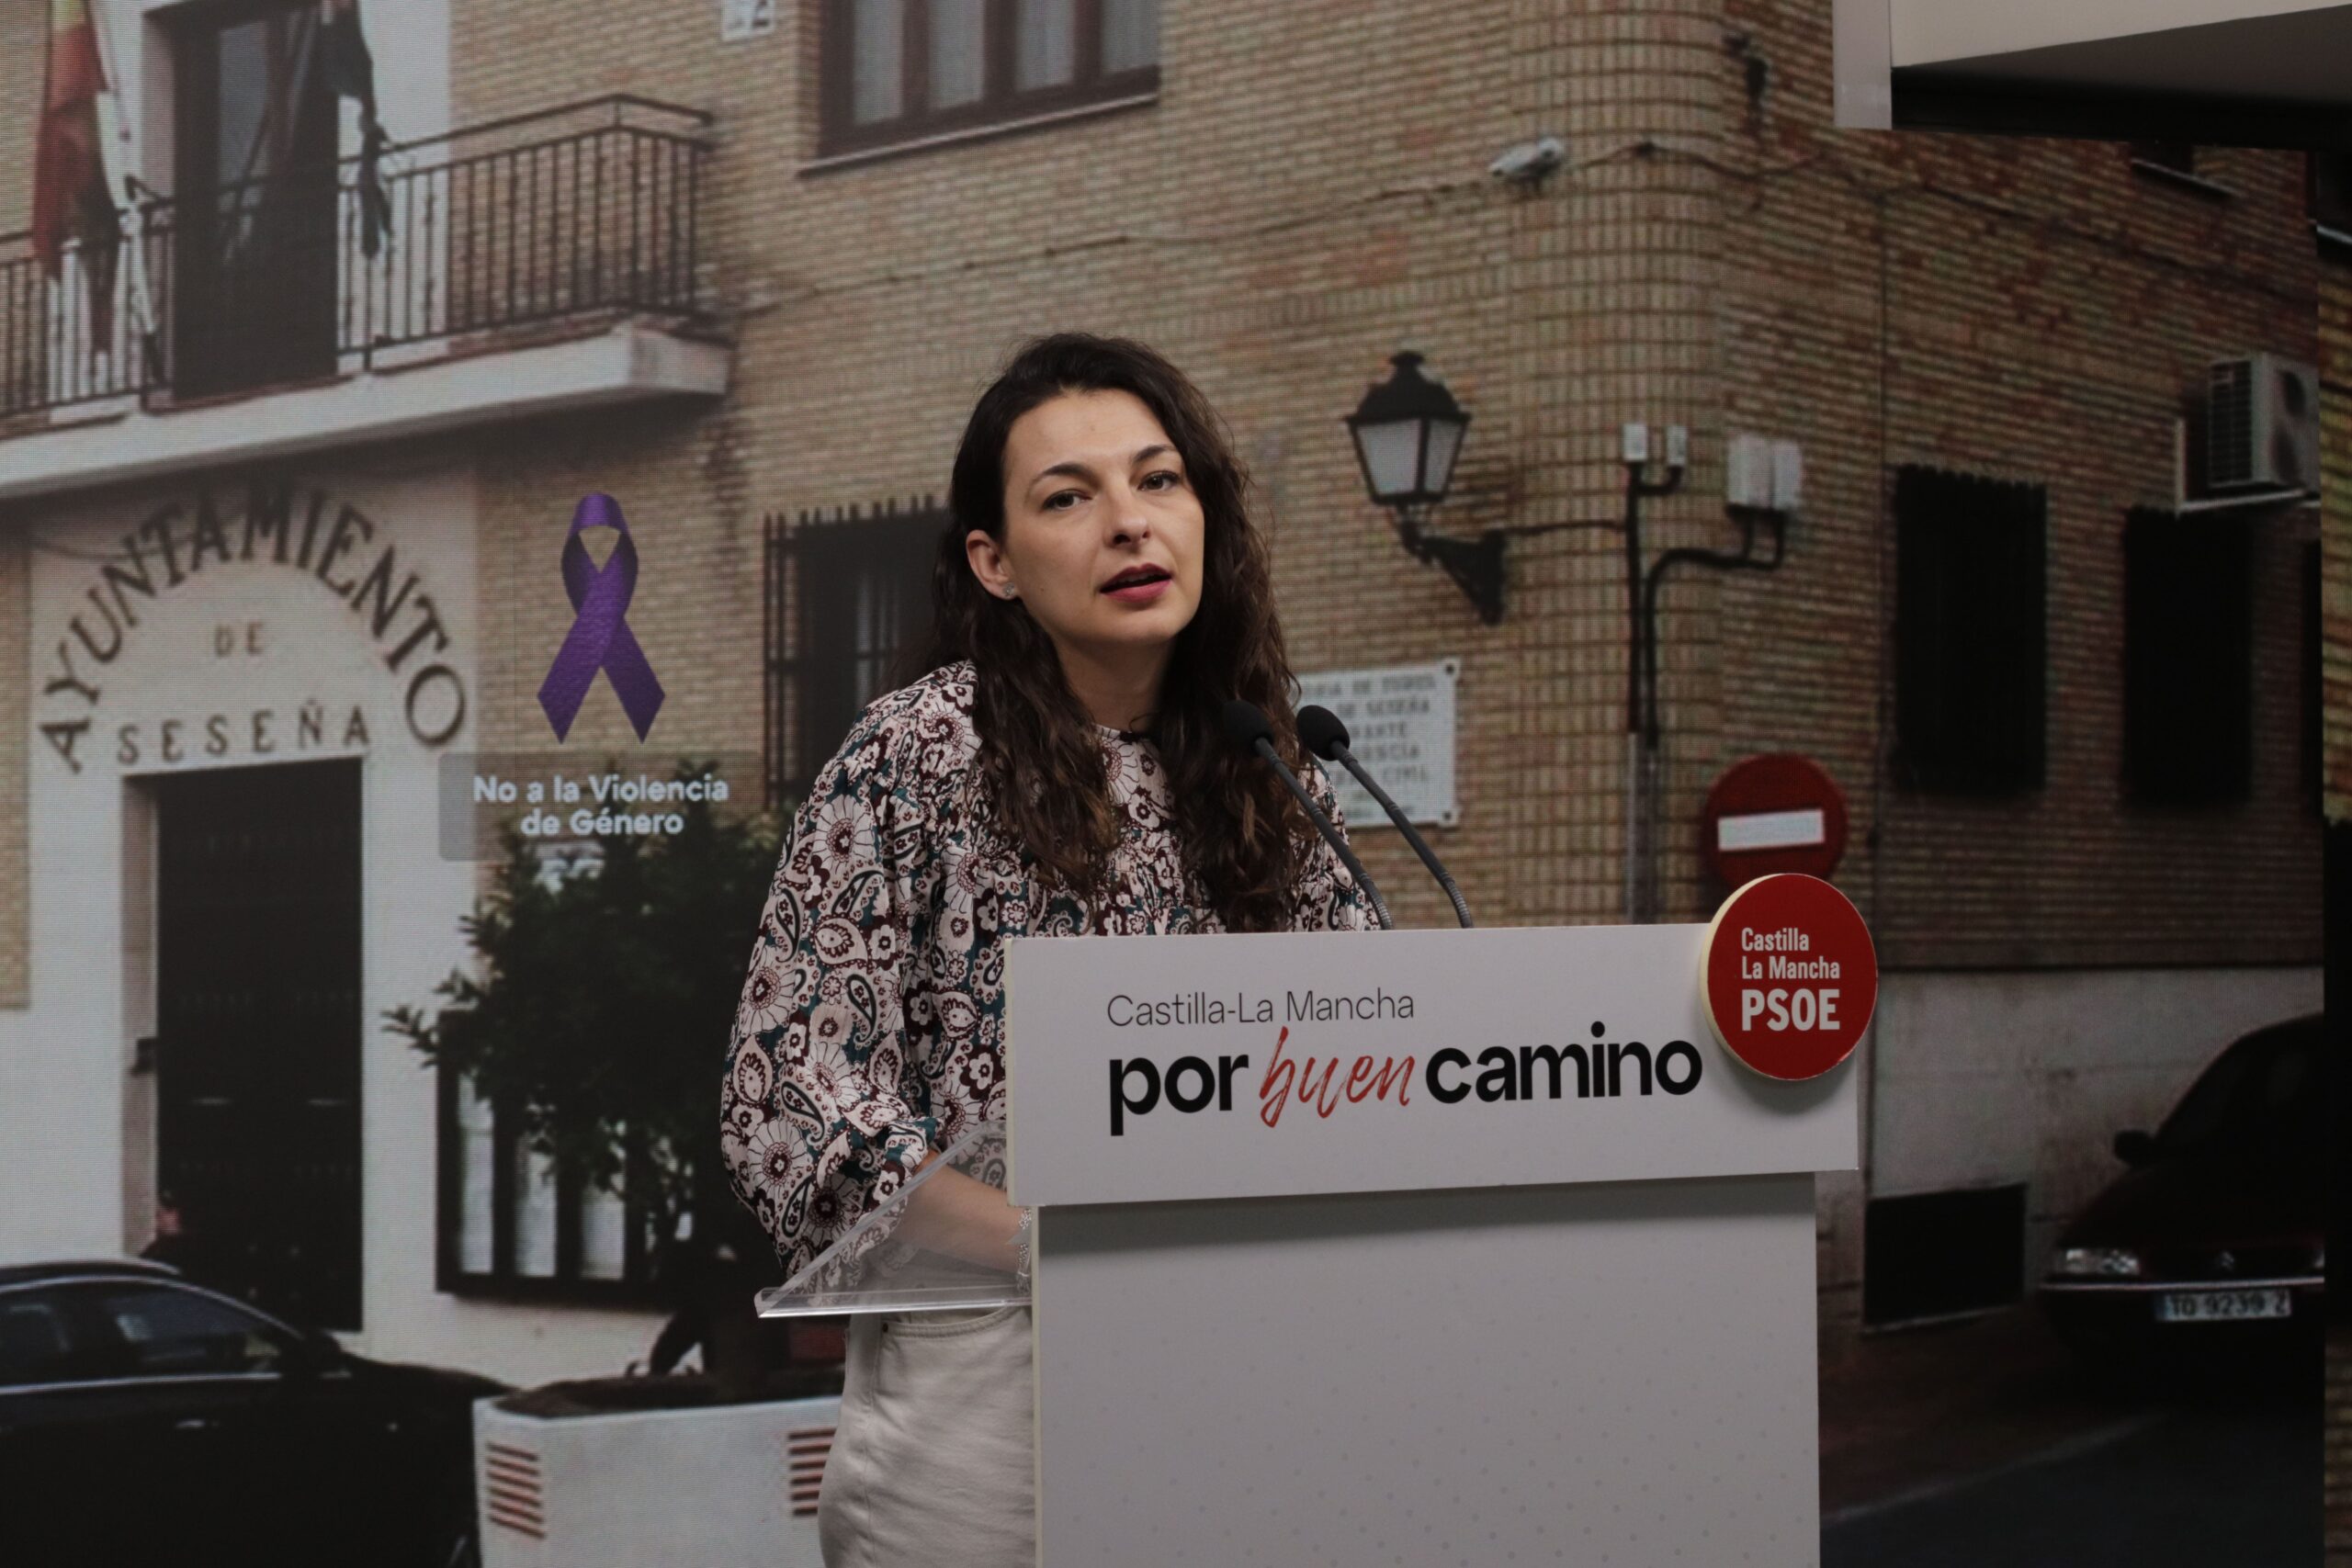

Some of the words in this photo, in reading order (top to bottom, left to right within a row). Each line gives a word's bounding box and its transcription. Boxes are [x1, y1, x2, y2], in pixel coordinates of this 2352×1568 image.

[40, 481, 467, 774] AYUNTAMIENTO
[213, 622, 265, 658] DE
[117, 698, 369, 766] SESEÑA
[472, 774, 518, 804] No
[526, 781, 546, 804] a
[553, 774, 581, 804] la
[588, 773, 730, 804] Violencia
[520, 808, 561, 837] de
[569, 807, 685, 837] Género
[1741, 927, 1810, 952] Castilla
[1741, 955, 1763, 980] La
[1769, 955, 1841, 980] Mancha
[1107, 991, 1274, 1027] Castilla-La
[1285, 987, 1415, 1022] Mancha
[1741, 987, 1841, 1032] PSOE
[1109, 1054, 1250, 1137] por
[1259, 1025, 1416, 1128] buen
[1425, 1021, 1703, 1104] camino
